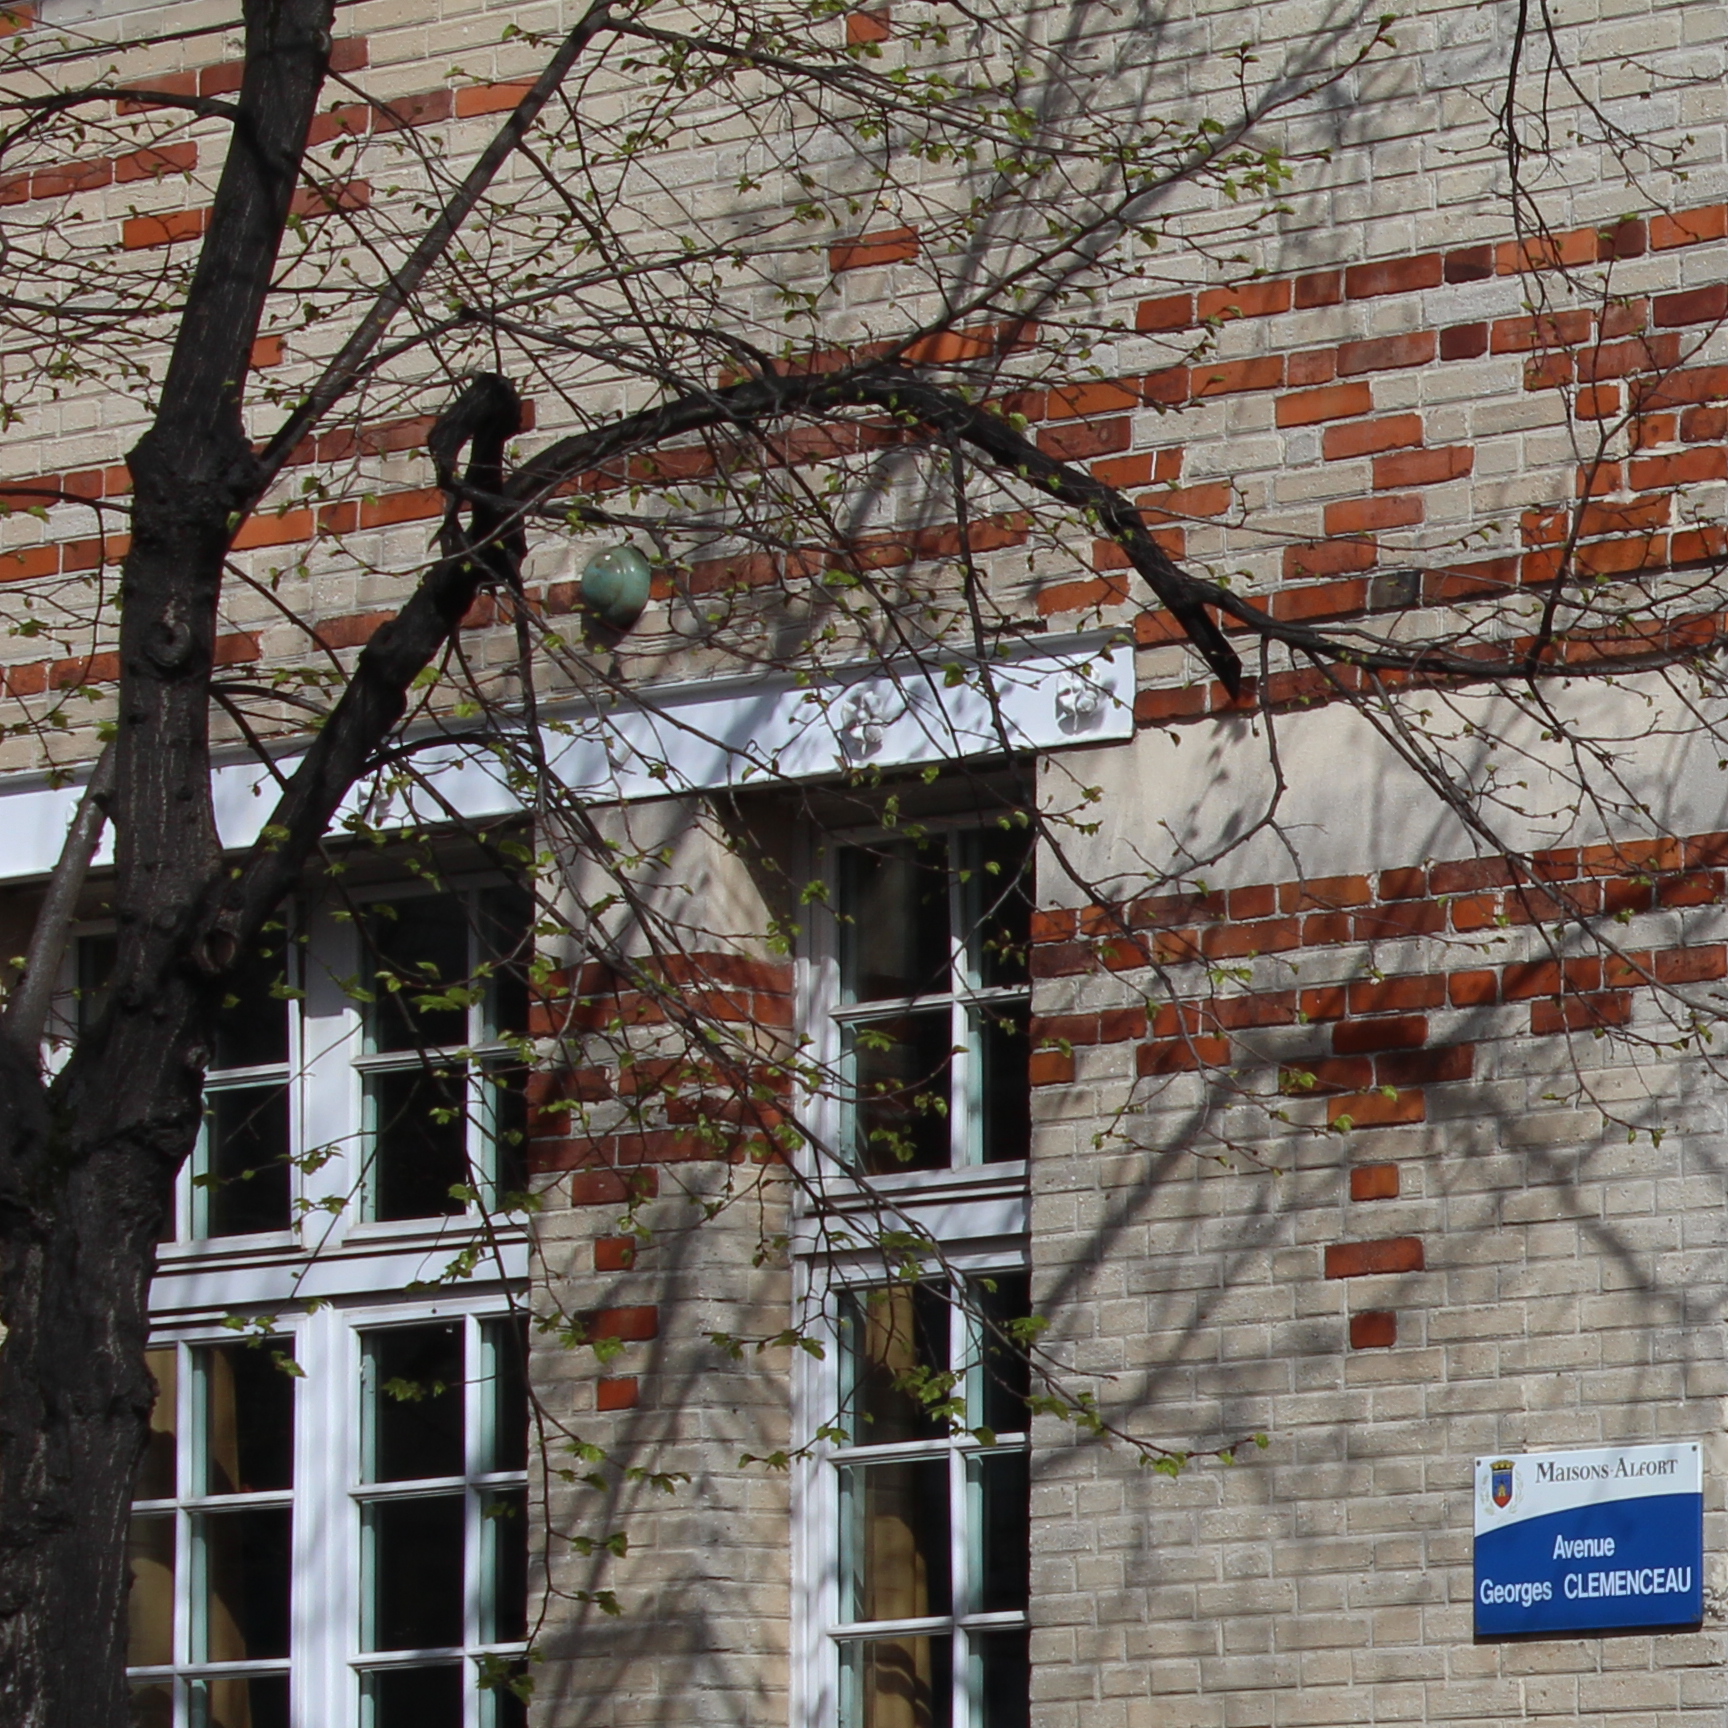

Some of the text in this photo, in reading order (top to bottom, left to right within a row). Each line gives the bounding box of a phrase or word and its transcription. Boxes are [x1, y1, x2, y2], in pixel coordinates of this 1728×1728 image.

[1553, 1534, 1615, 1560] Avenue
[1480, 1566, 1692, 1607] Georges CLEMENCEAU
